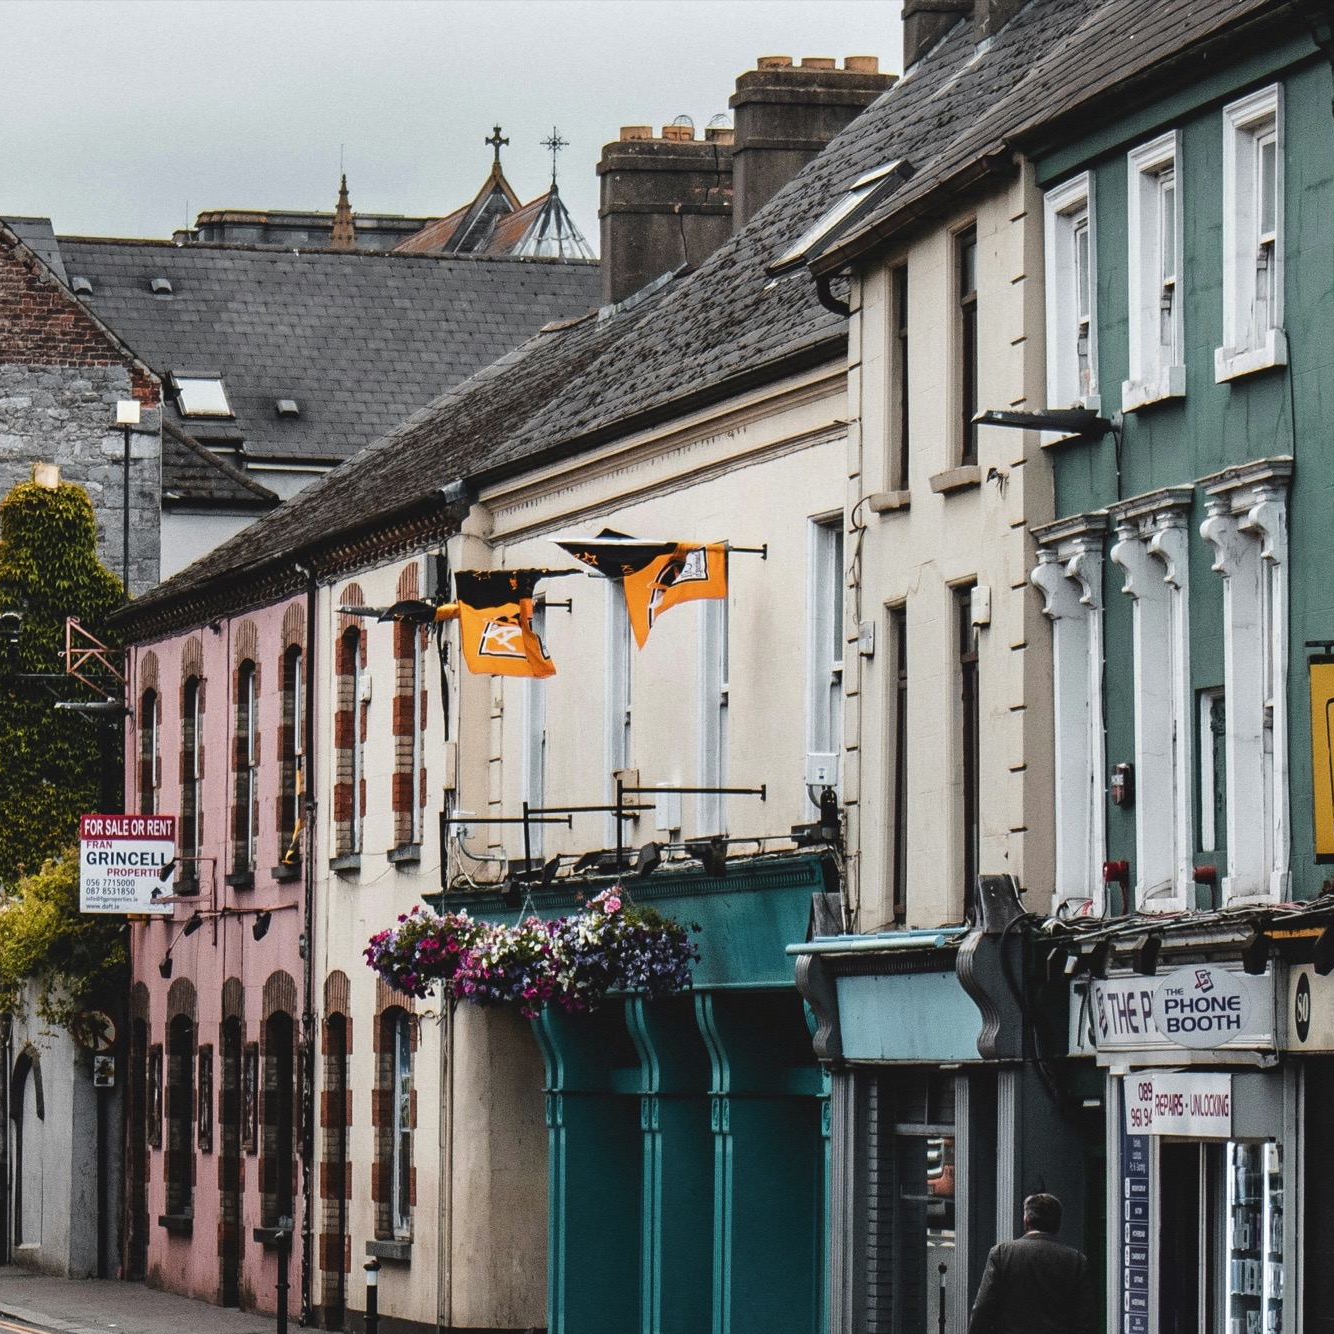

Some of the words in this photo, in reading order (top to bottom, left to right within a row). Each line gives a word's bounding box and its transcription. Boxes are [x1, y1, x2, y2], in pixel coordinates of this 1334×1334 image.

[85, 819, 103, 836] FOR
[105, 819, 129, 836] SALE
[131, 819, 145, 836] OR
[147, 819, 172, 836] RENT
[86, 841, 112, 849] FRAN
[87, 851, 167, 866] GRINCELL
[107, 868, 162, 877] PROPERTIE
[86, 879, 100, 887] 056
[103, 879, 135, 887] 7715000
[86, 887, 100, 895] 087
[1165, 988, 1183, 996] THE
[1107, 992, 1139, 1034] THE
[1164, 995, 1241, 1014] PHONE
[1297, 992, 1309, 1023] 80
[1167, 1014, 1241, 1033] BOOTH
[1138, 1082, 1153, 1101] 089
[1155, 1094, 1183, 1116] REPAIRS
[1190, 1094, 1229, 1117] UNLOCKING
